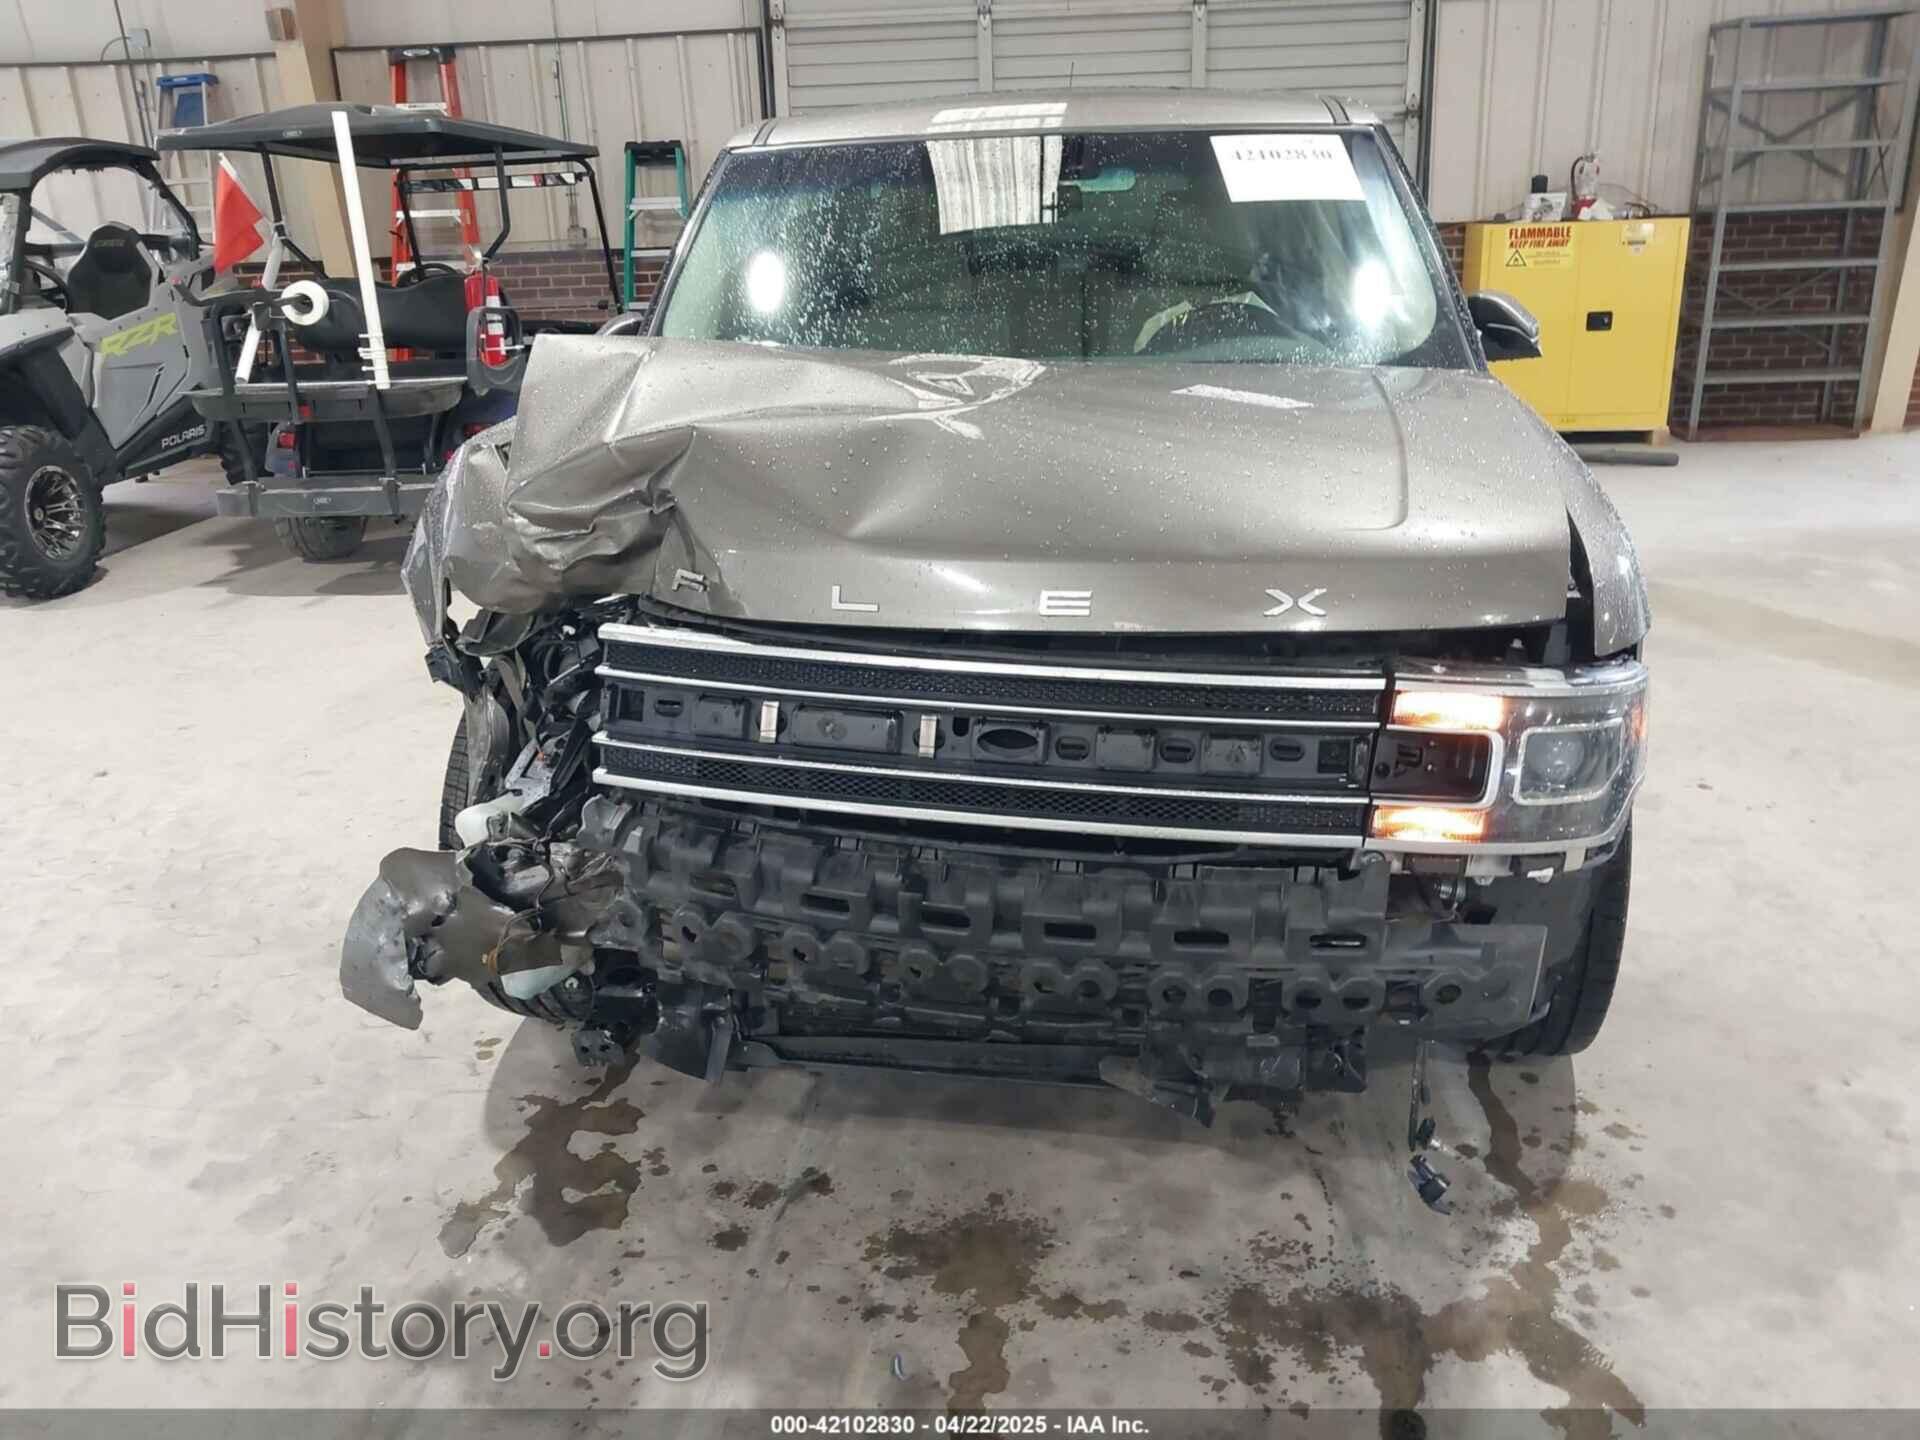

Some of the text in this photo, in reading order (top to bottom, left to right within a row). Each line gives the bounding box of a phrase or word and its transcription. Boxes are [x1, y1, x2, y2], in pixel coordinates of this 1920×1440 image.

[1509, 226, 1571, 240] FLAMMABLE
[1509, 239, 1569, 249] KEEP FIRE AWAY
[100, 312, 179, 357] RZR
[161, 424, 206, 449] POLARIS
